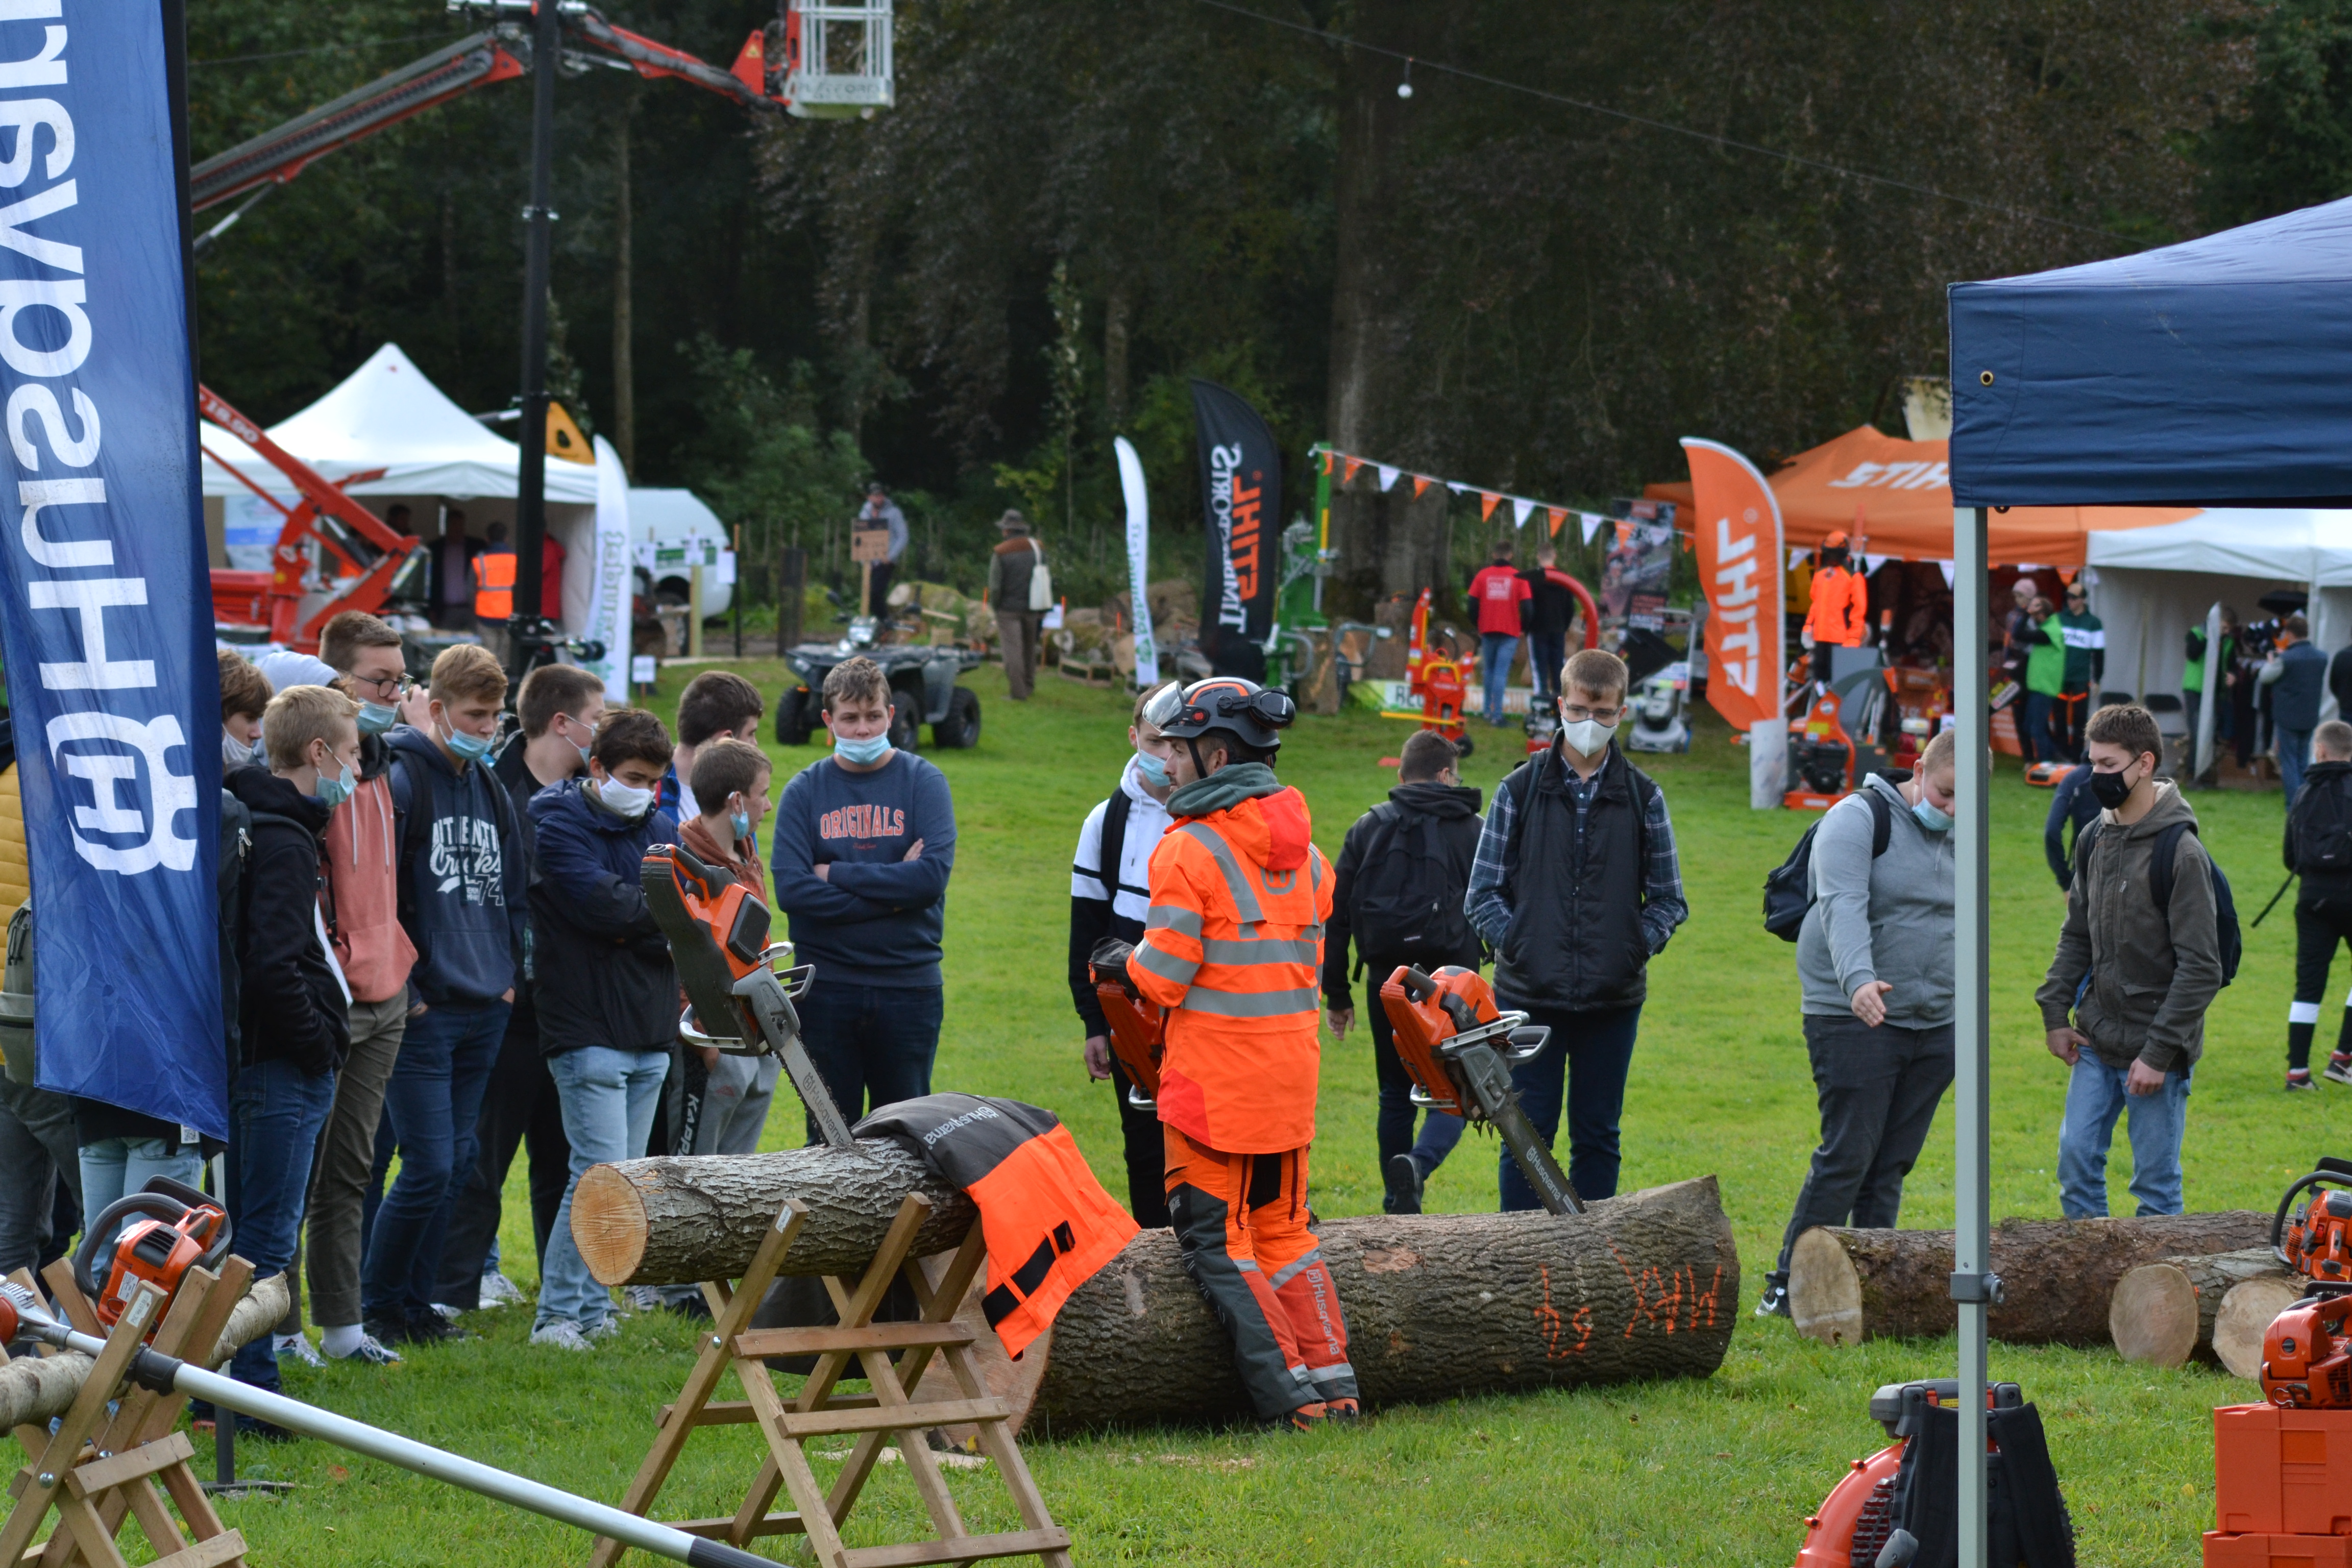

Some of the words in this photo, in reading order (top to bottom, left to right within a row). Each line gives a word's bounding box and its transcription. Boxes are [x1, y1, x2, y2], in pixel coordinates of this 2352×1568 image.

[432, 816, 500, 851] AUTENTI
[820, 804, 904, 840] ORIGINALS
[475, 873, 504, 906] 74
[810, 1085, 844, 1145] Husqvarna
[923, 1110, 987, 1145] Husqvarna
[1532, 1155, 1561, 1201] Husqvarna
[1312, 1283, 1340, 1355] Husqvarna
